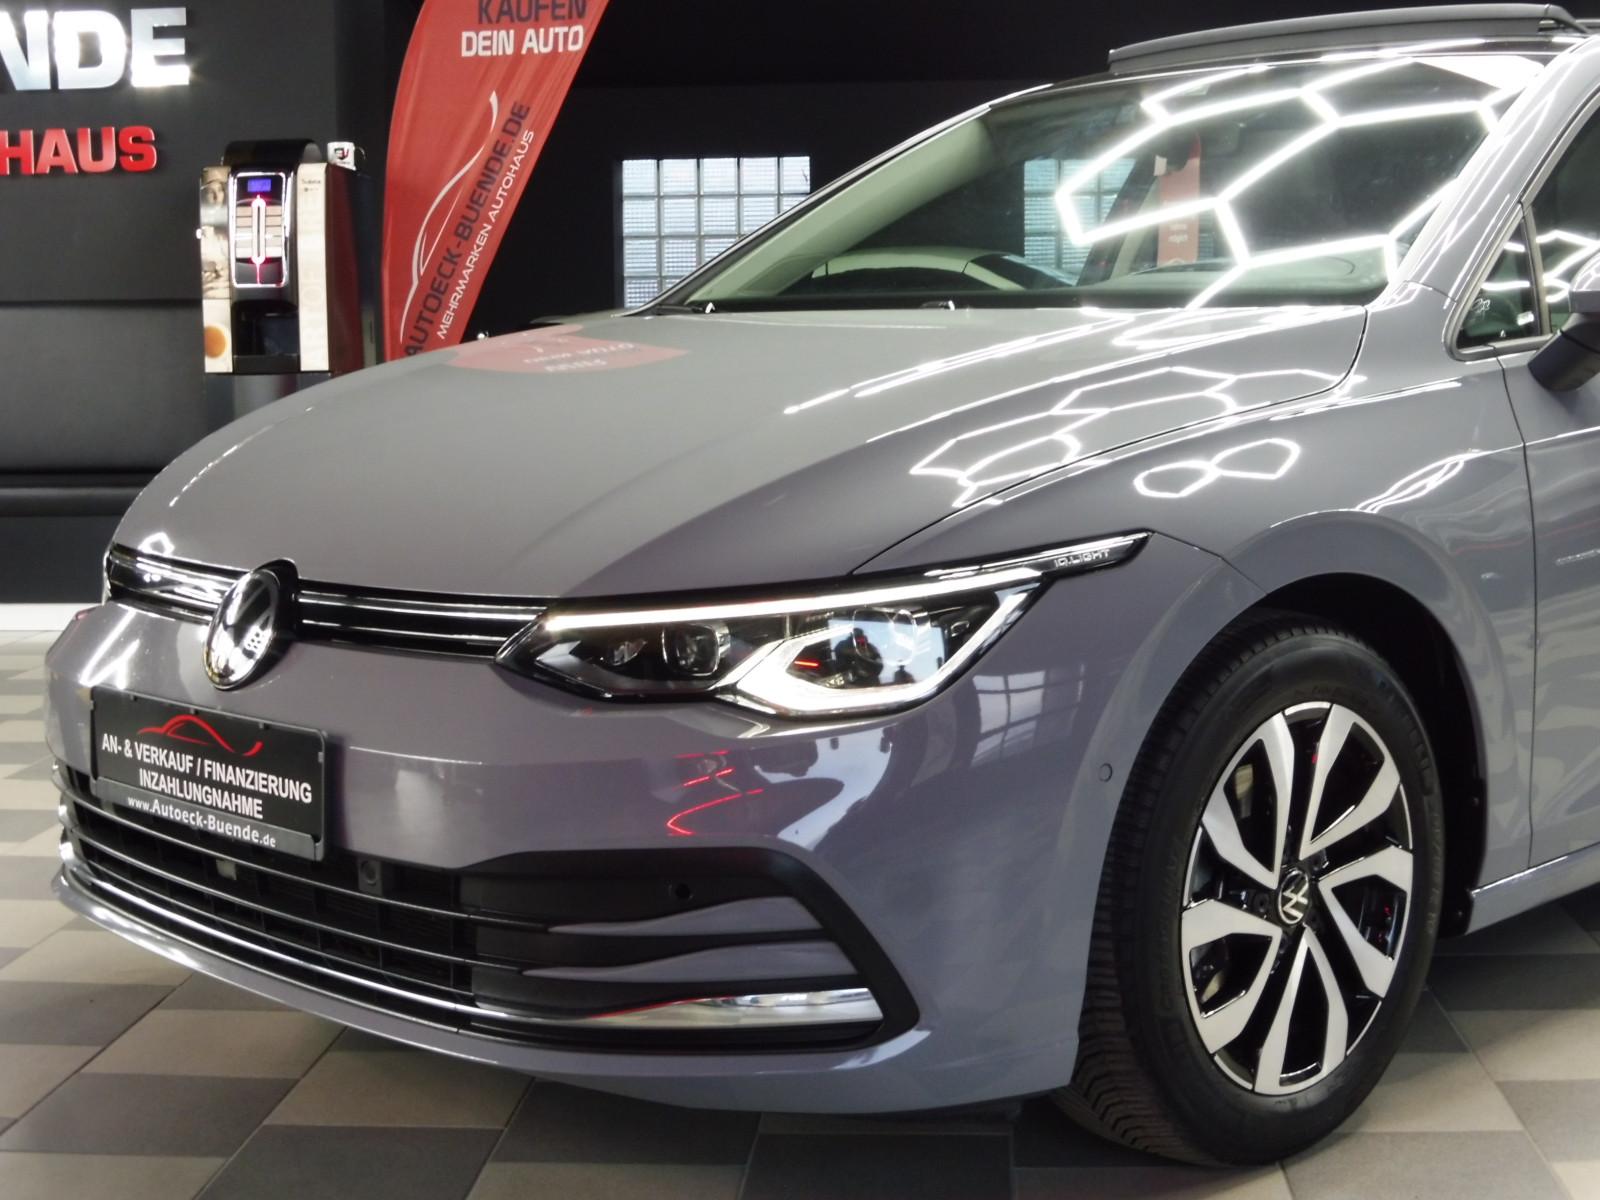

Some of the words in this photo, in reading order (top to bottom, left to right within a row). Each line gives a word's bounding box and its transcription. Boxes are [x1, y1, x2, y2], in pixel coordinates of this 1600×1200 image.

[478, 0, 587, 24] KAUFEN
[461, 29, 514, 57] DEIN
[521, 25, 584, 55] AUTO
[404, 101, 530, 356] AUTOECK-BUENDE.DE
[437, 223, 492, 340] MEHRMARKEN
[489, 129, 534, 223] AUTOHAUS
[1054, 548, 1110, 568] IQ.LIGHT
[102, 733, 121, 754] AN-
[124, 740, 133, 758] &
[135, 741, 194, 774] VERKAUF
[204, 759, 312, 804] FINANZIERUNG
[139, 767, 264, 819] INZAHLUNGNAHME
[128, 795, 276, 848] www.Autoeck-Buende.de
